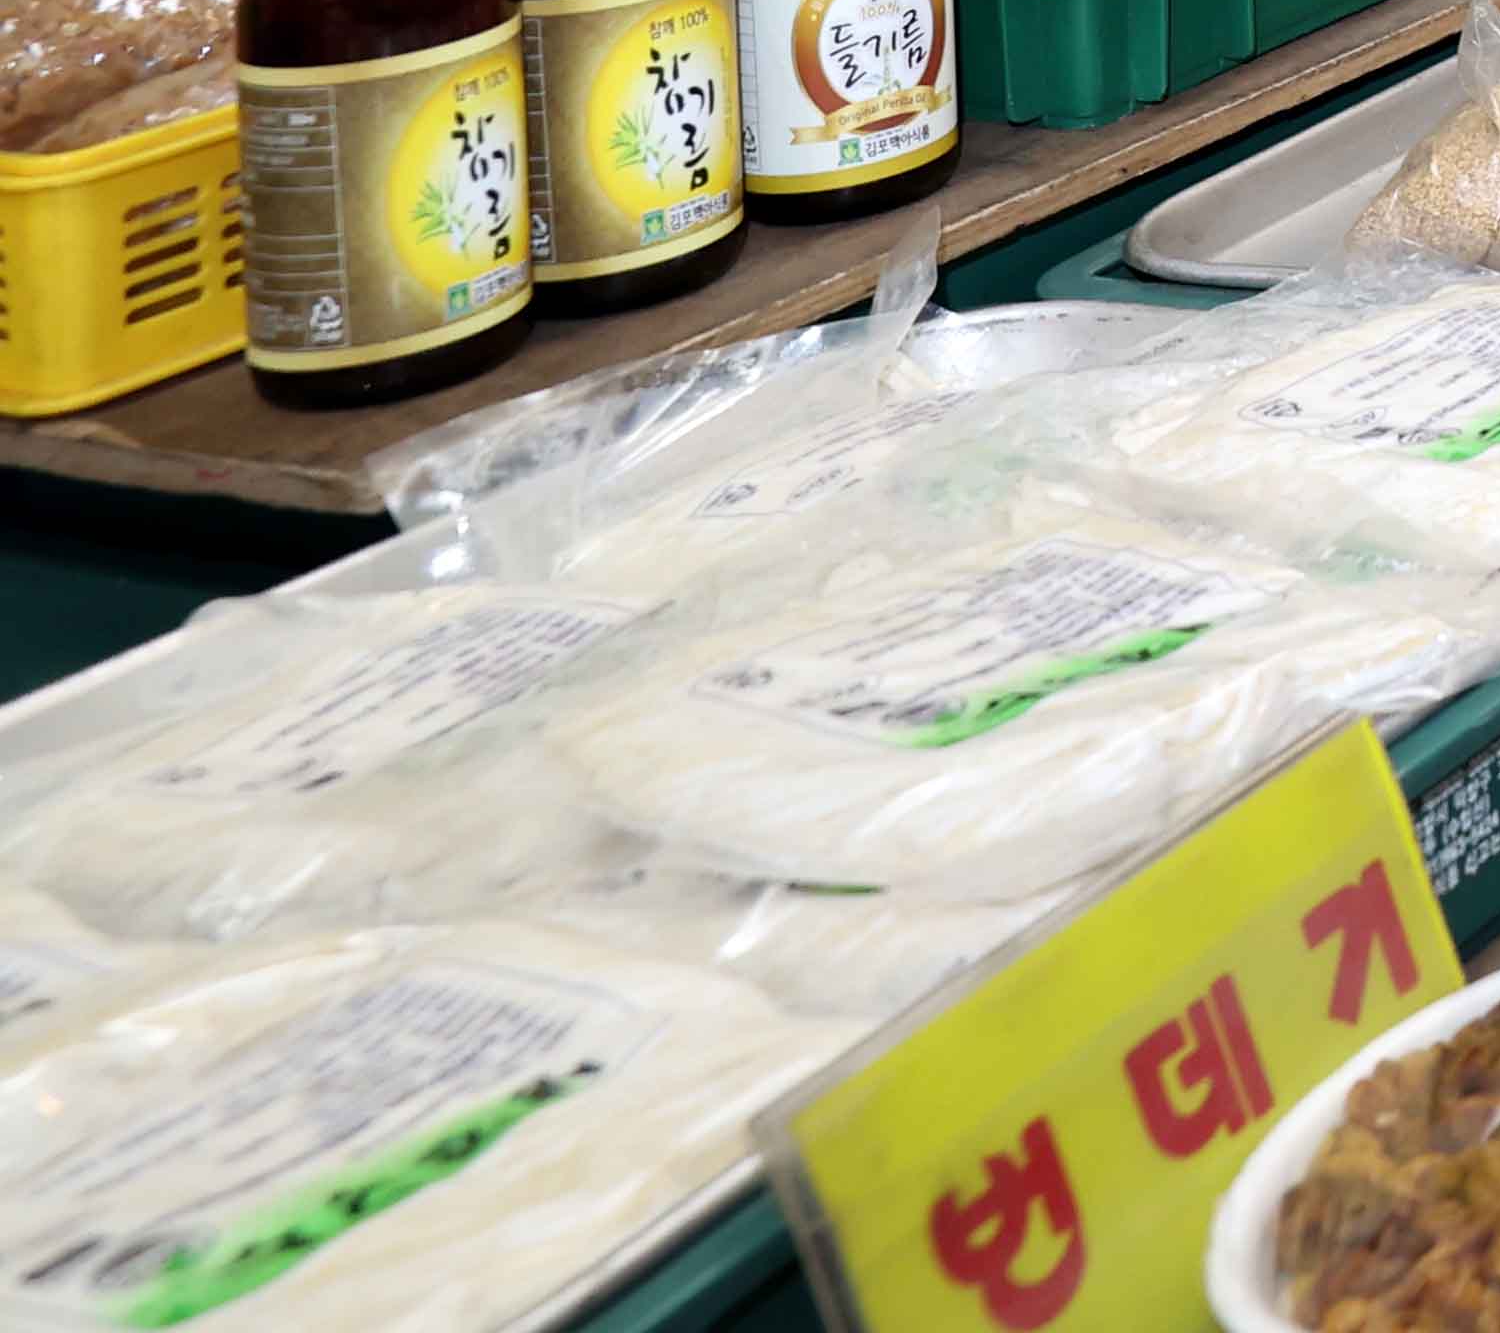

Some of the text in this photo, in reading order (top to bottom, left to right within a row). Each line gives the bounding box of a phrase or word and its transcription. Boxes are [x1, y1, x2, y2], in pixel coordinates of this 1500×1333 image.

[649, 7, 710, 40] 참깨 100%
[830, 8, 928, 89] 들기름
[645, 46, 716, 191] 참기름
[838, 104, 880, 125] Original
[452, 110, 516, 262] 참기름
[928, 857, 1421, 1332] 번데기
